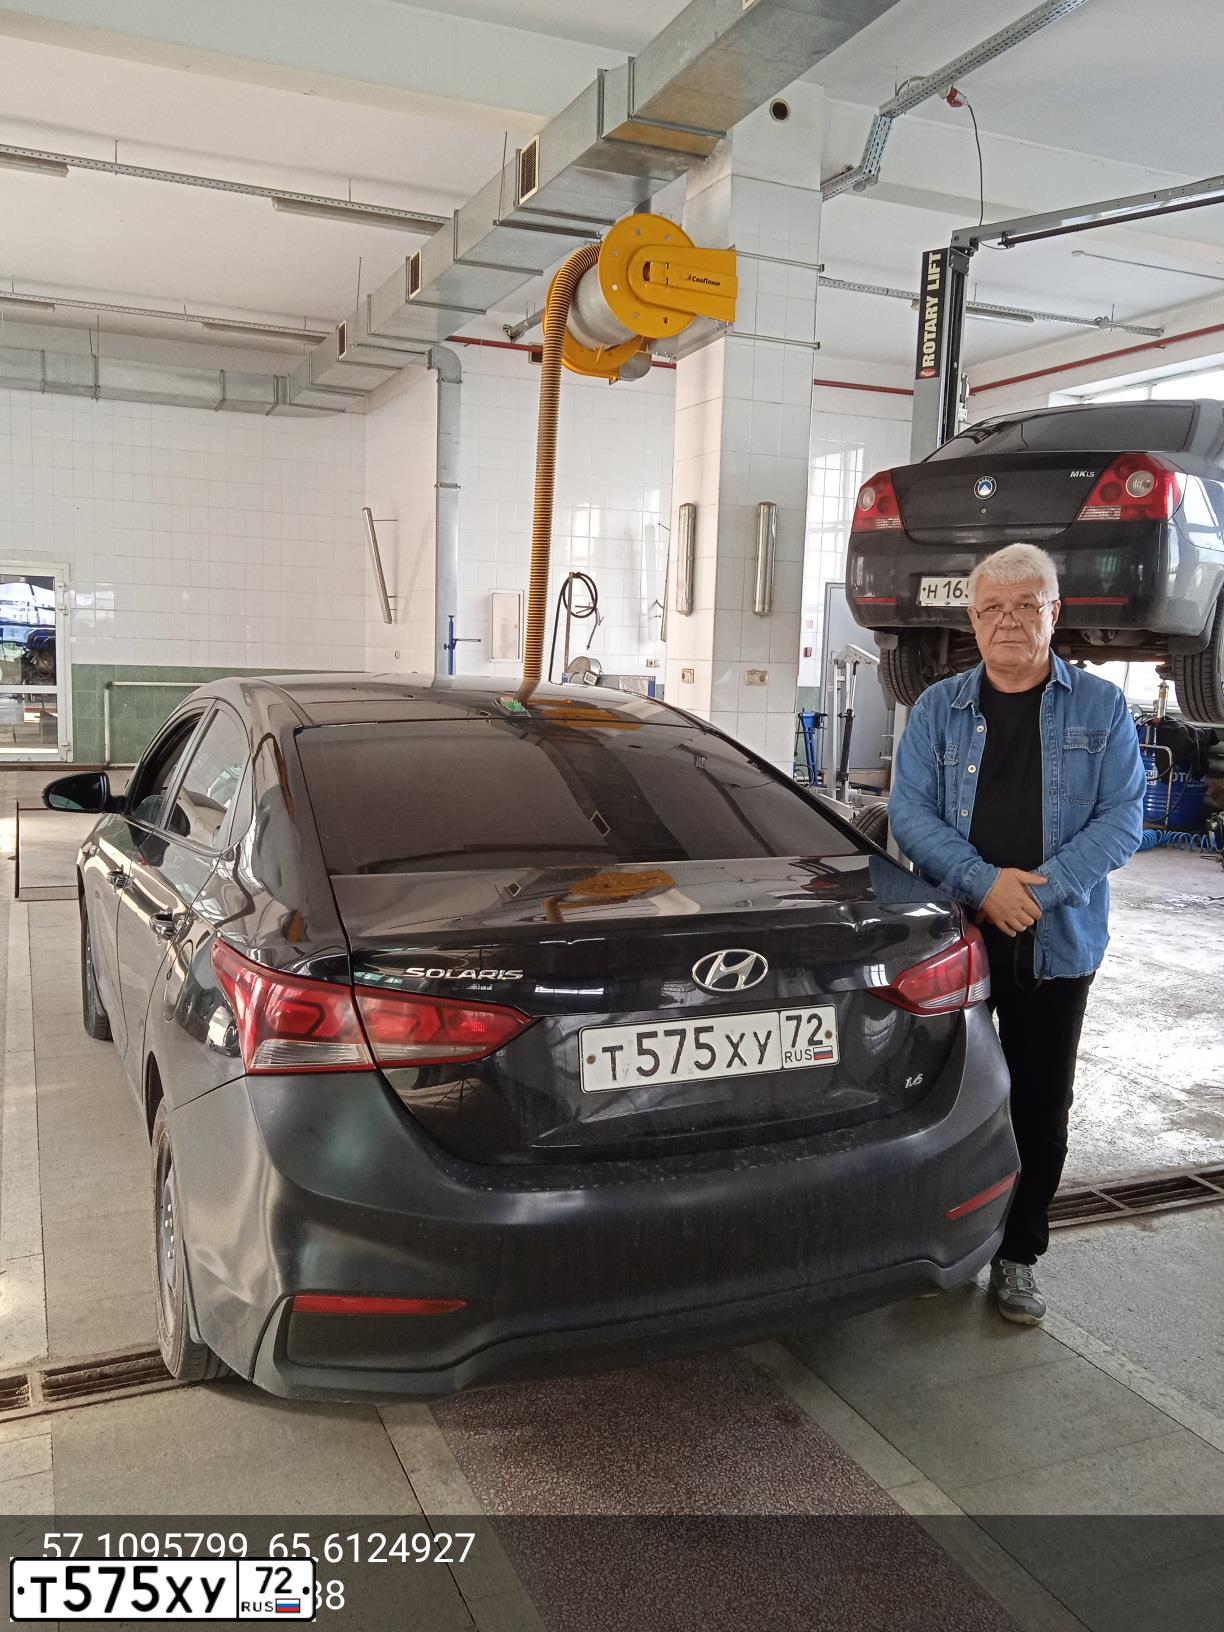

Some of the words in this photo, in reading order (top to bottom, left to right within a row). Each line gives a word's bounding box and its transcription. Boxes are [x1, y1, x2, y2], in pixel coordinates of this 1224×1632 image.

[927, 252, 942, 291] LIFT
[922, 296, 939, 368] ROTARY
[403, 967, 524, 980] SOLARIS
[601, 1025, 773, 1081] Т575ХУ
[785, 1013, 824, 1048] 72
[784, 1048, 813, 1063] RUS
